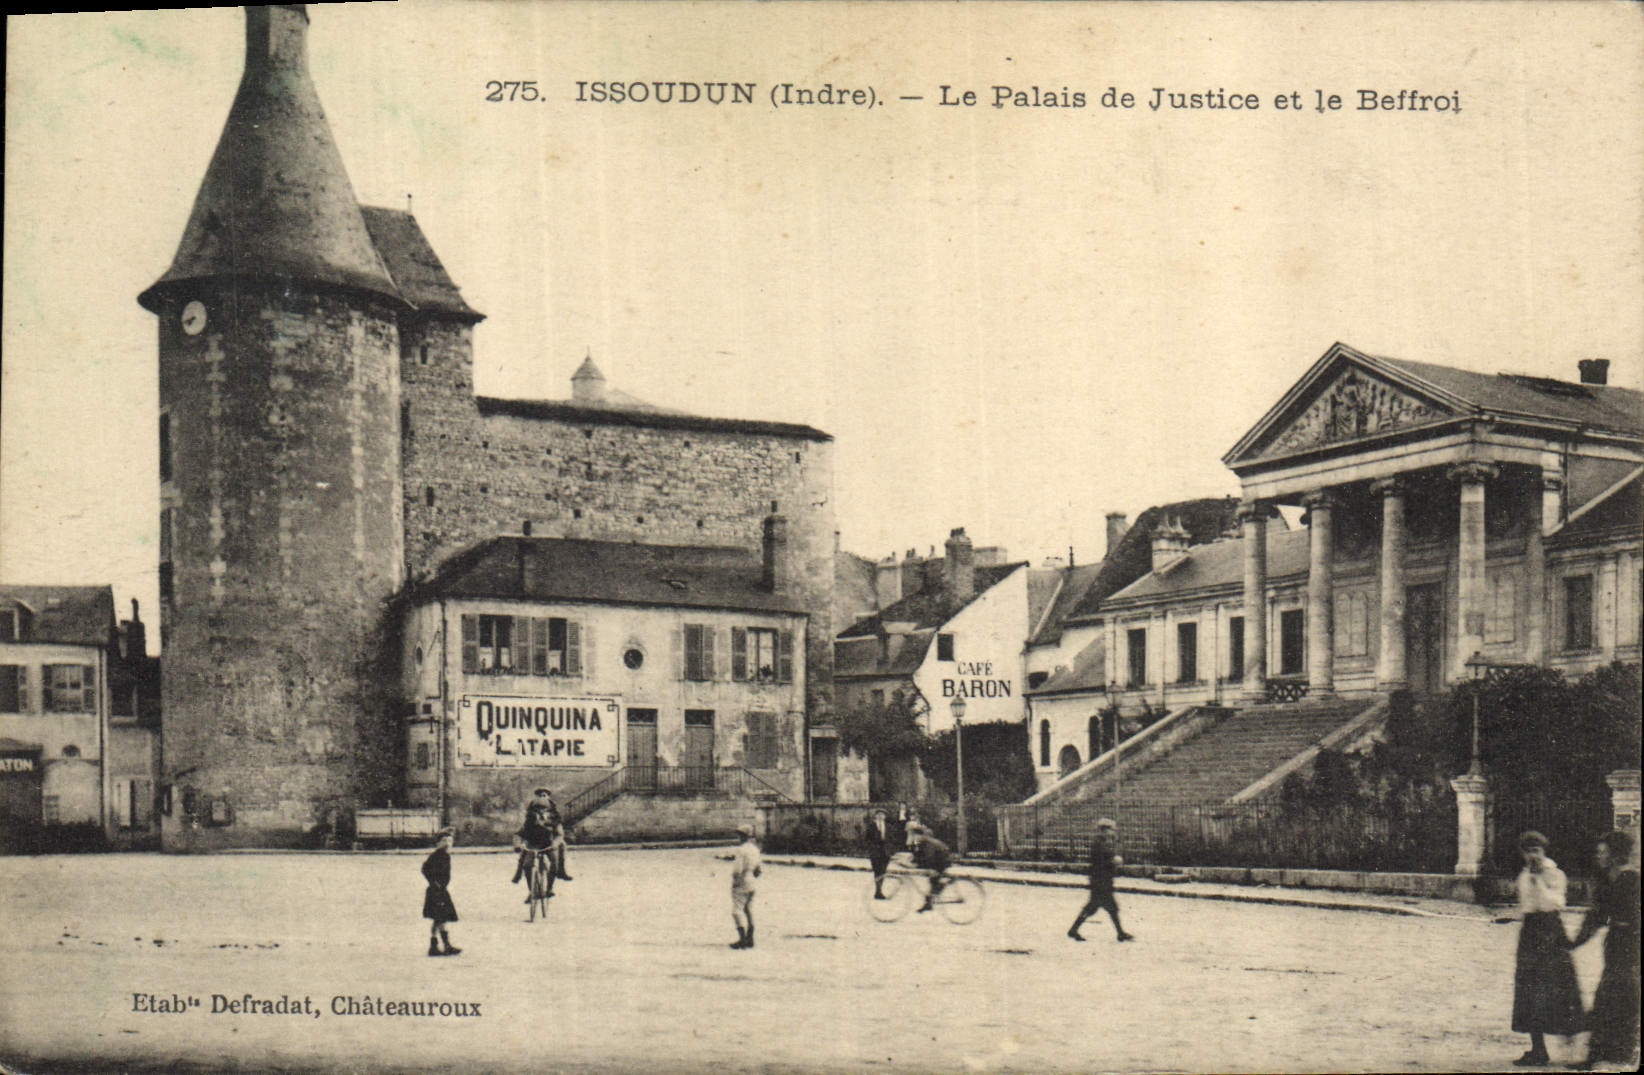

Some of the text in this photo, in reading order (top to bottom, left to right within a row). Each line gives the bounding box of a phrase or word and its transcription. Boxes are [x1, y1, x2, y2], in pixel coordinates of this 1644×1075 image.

[957, 659, 993, 676] CAFÉ
[942, 679, 1011, 698] BARON
[476, 700, 602, 740] QUINQUINA
